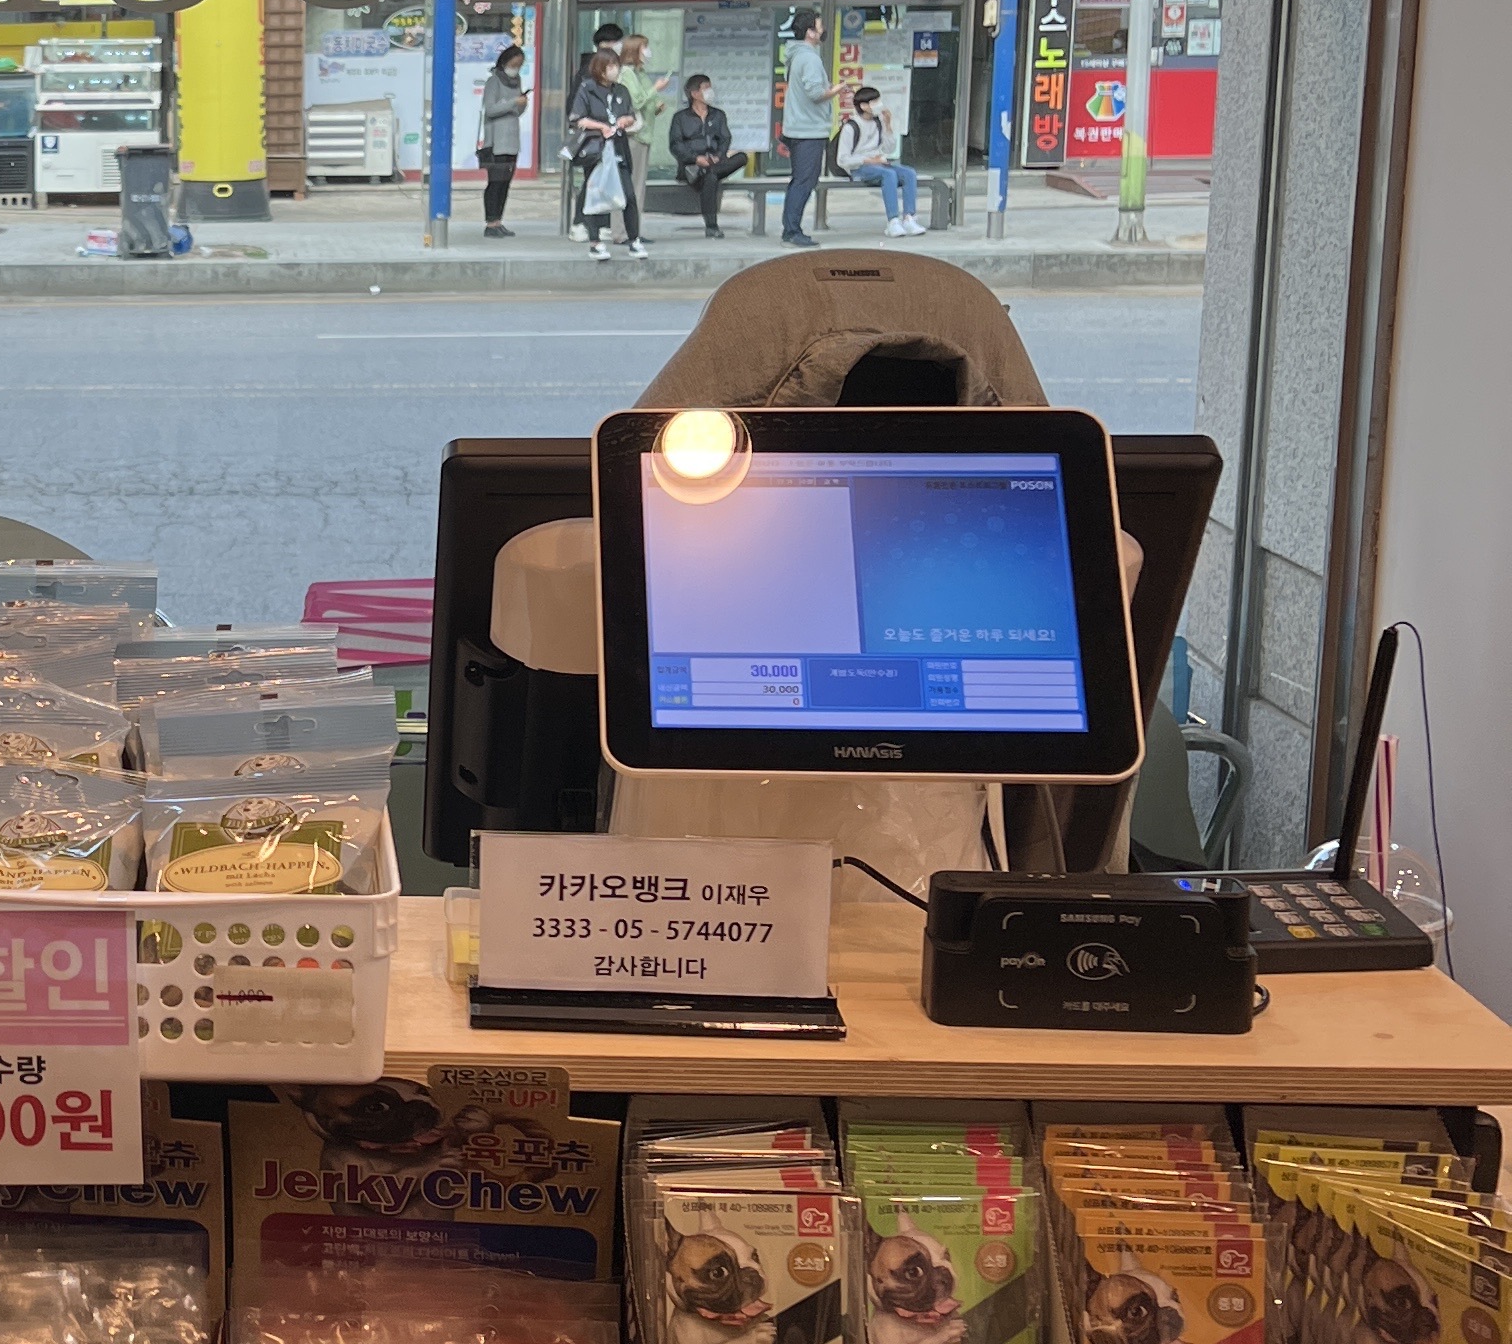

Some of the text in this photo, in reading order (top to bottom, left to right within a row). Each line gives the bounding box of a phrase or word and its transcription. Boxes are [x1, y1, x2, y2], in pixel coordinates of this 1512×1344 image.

[884, 628, 1056, 643] 오늘도 즐거운 하루 되세요!
[750, 663, 798, 680] 30,000
[762, 684, 800, 696] 30,000
[539, 873, 771, 906] 카카오뱅크 이재우
[1060, 912, 1118, 925] SAMSUNG
[532, 917, 774, 944] 3333 05 5744077
[593, 955, 708, 980] 감사합니다
[508, 1088, 558, 1110] UP!
[463, 1133, 596, 1172] 육포츄
